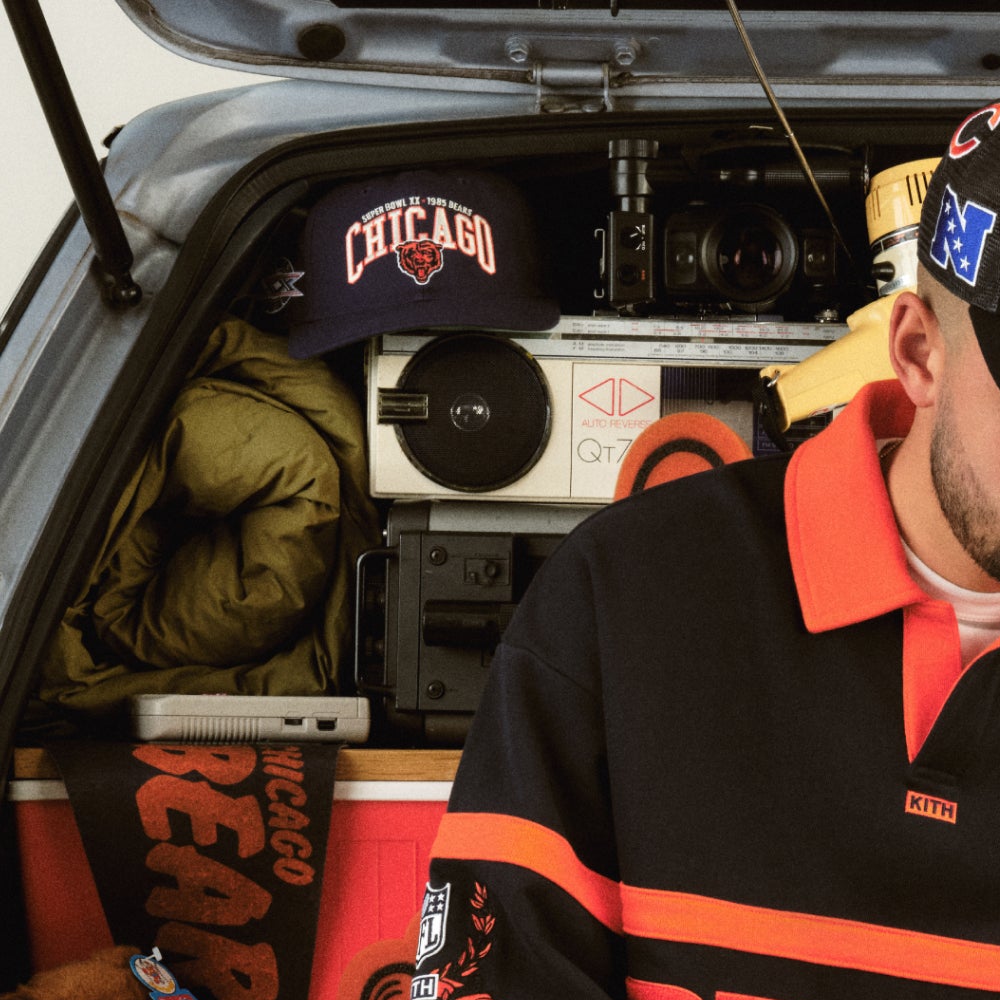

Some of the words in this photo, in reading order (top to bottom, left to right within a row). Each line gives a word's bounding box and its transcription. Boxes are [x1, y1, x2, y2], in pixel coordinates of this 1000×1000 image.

[361, 206, 385, 223] SUPER
[385, 198, 407, 212] BOWL
[408, 196, 421, 206] XX
[426, 196, 447, 207] 1985
[448, 201, 473, 217] BEARS
[930, 183, 997, 287] N
[345, 205, 497, 285] CHICAGO
[582, 418, 607, 429] AUTO
[261, 747, 316, 886] HICAGO
[910, 795, 954, 818] KITH
